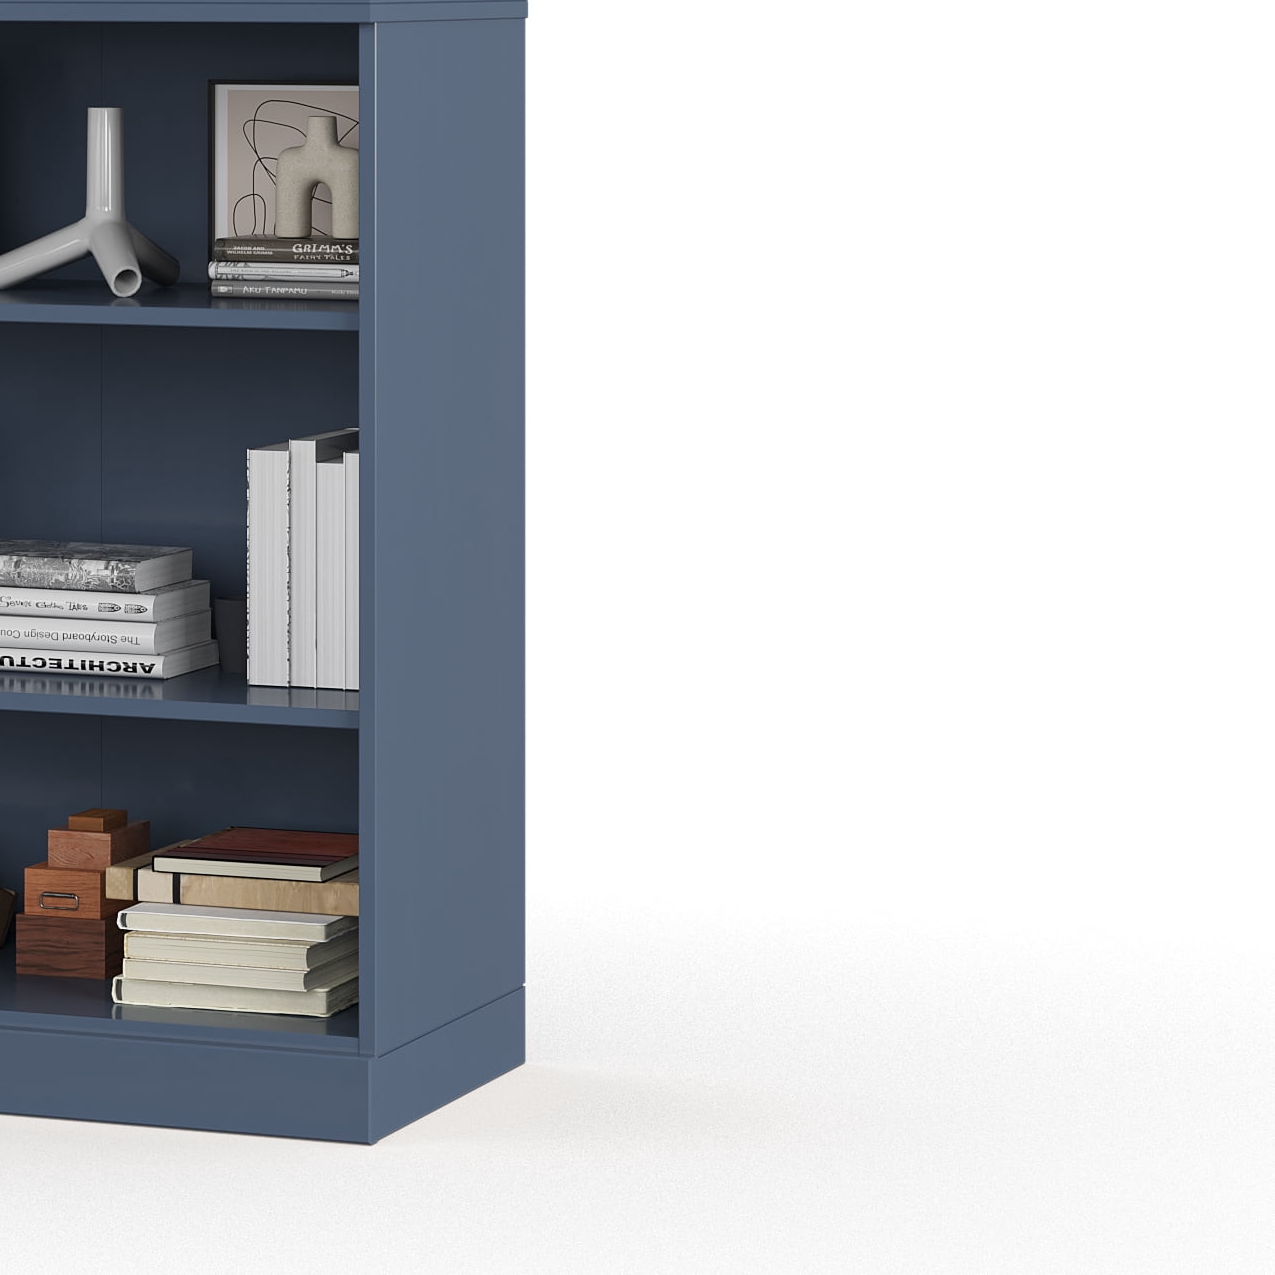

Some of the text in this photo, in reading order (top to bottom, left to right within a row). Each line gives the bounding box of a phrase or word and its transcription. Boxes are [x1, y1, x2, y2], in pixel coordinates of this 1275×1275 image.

[292, 243, 353, 254] GRIMM'S
[242, 286, 261, 294] AKU
[23, 628, 59, 641] Design
[62, 630, 118, 645] Storyboard
[120, 635, 141, 645] The
